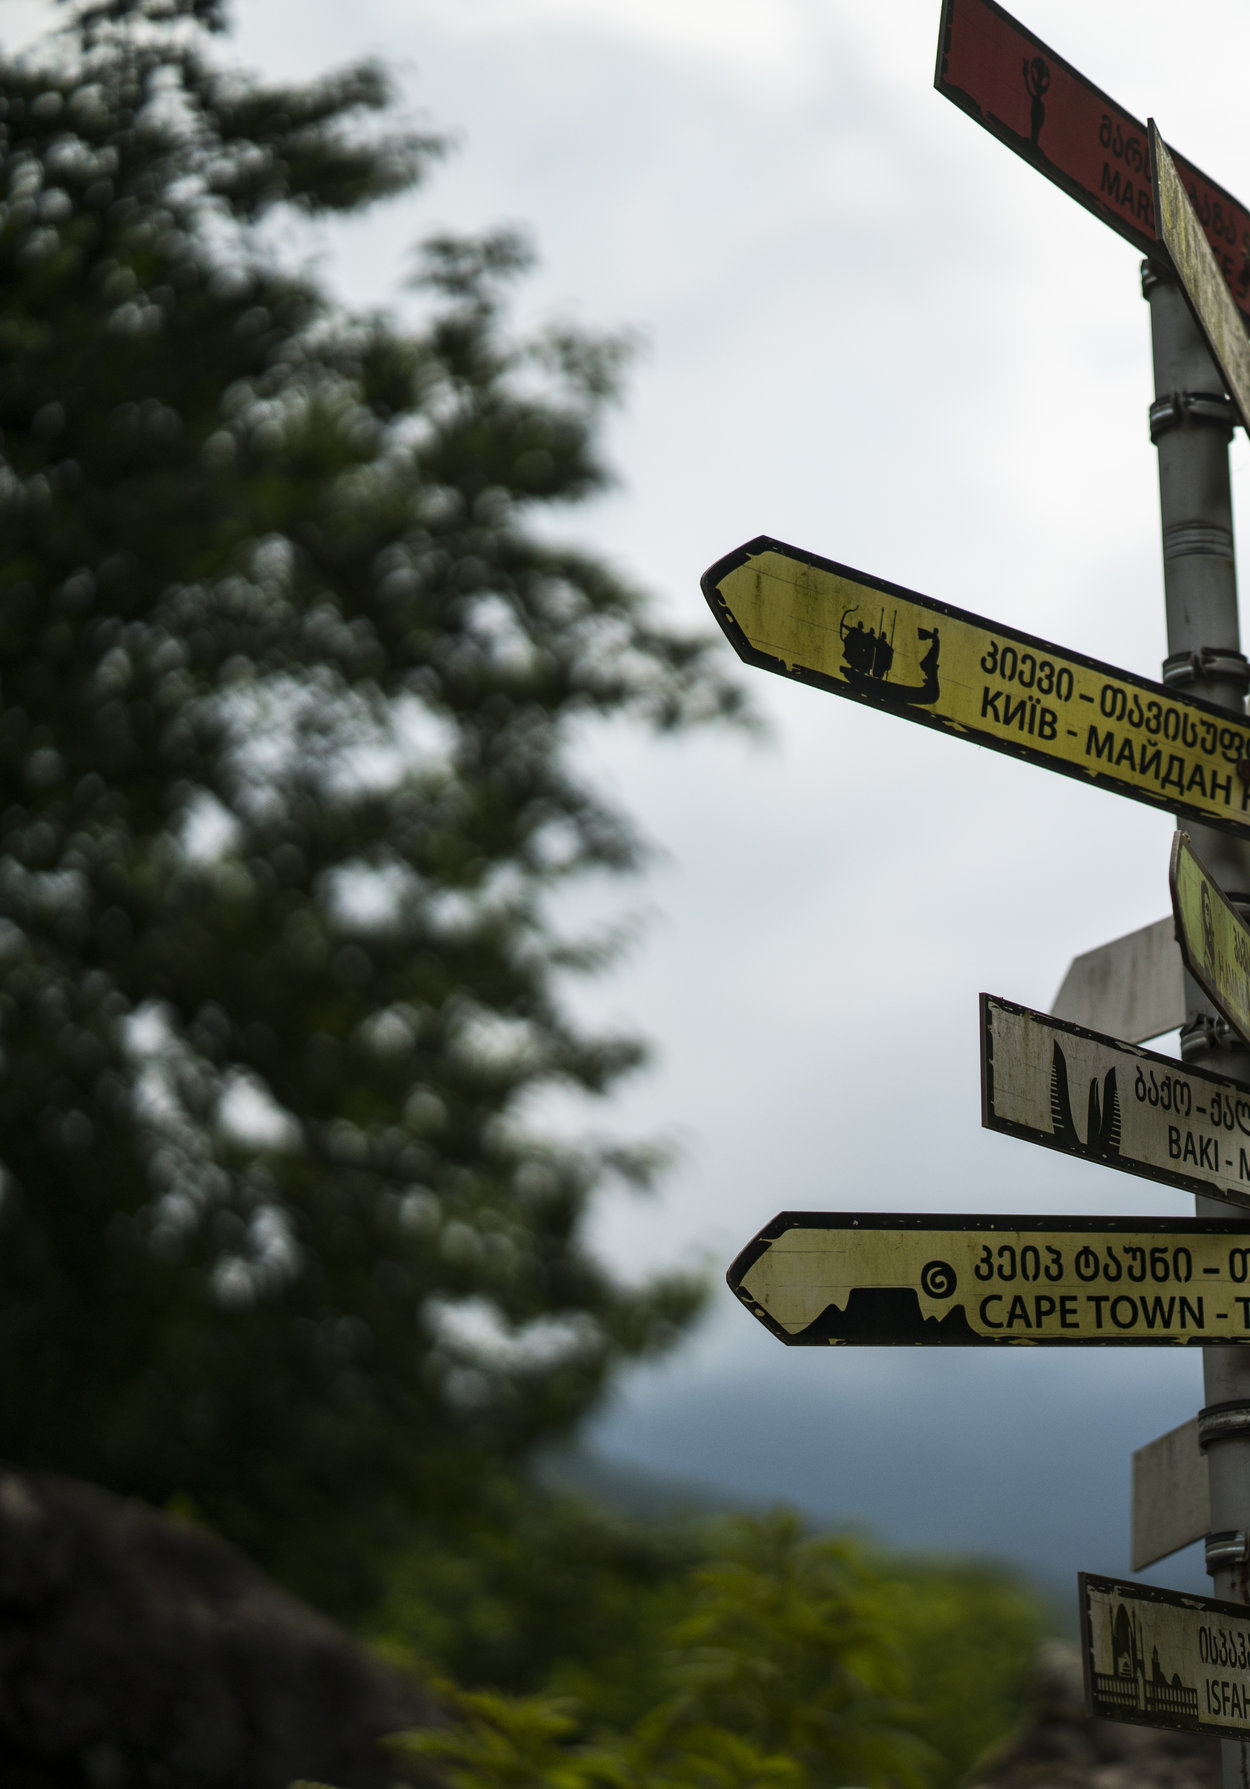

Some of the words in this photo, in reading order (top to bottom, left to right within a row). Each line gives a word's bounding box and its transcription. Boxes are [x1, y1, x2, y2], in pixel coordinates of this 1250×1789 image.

[1101, 162, 1156, 231] MAR
[981, 686, 1058, 741] КИЇВ
[1085, 725, 1232, 805] МАЙДАН
[1168, 1125, 1219, 1172] BAKI
[979, 1294, 1080, 1329] CAPE
[1086, 1295, 1204, 1329] TOWN
